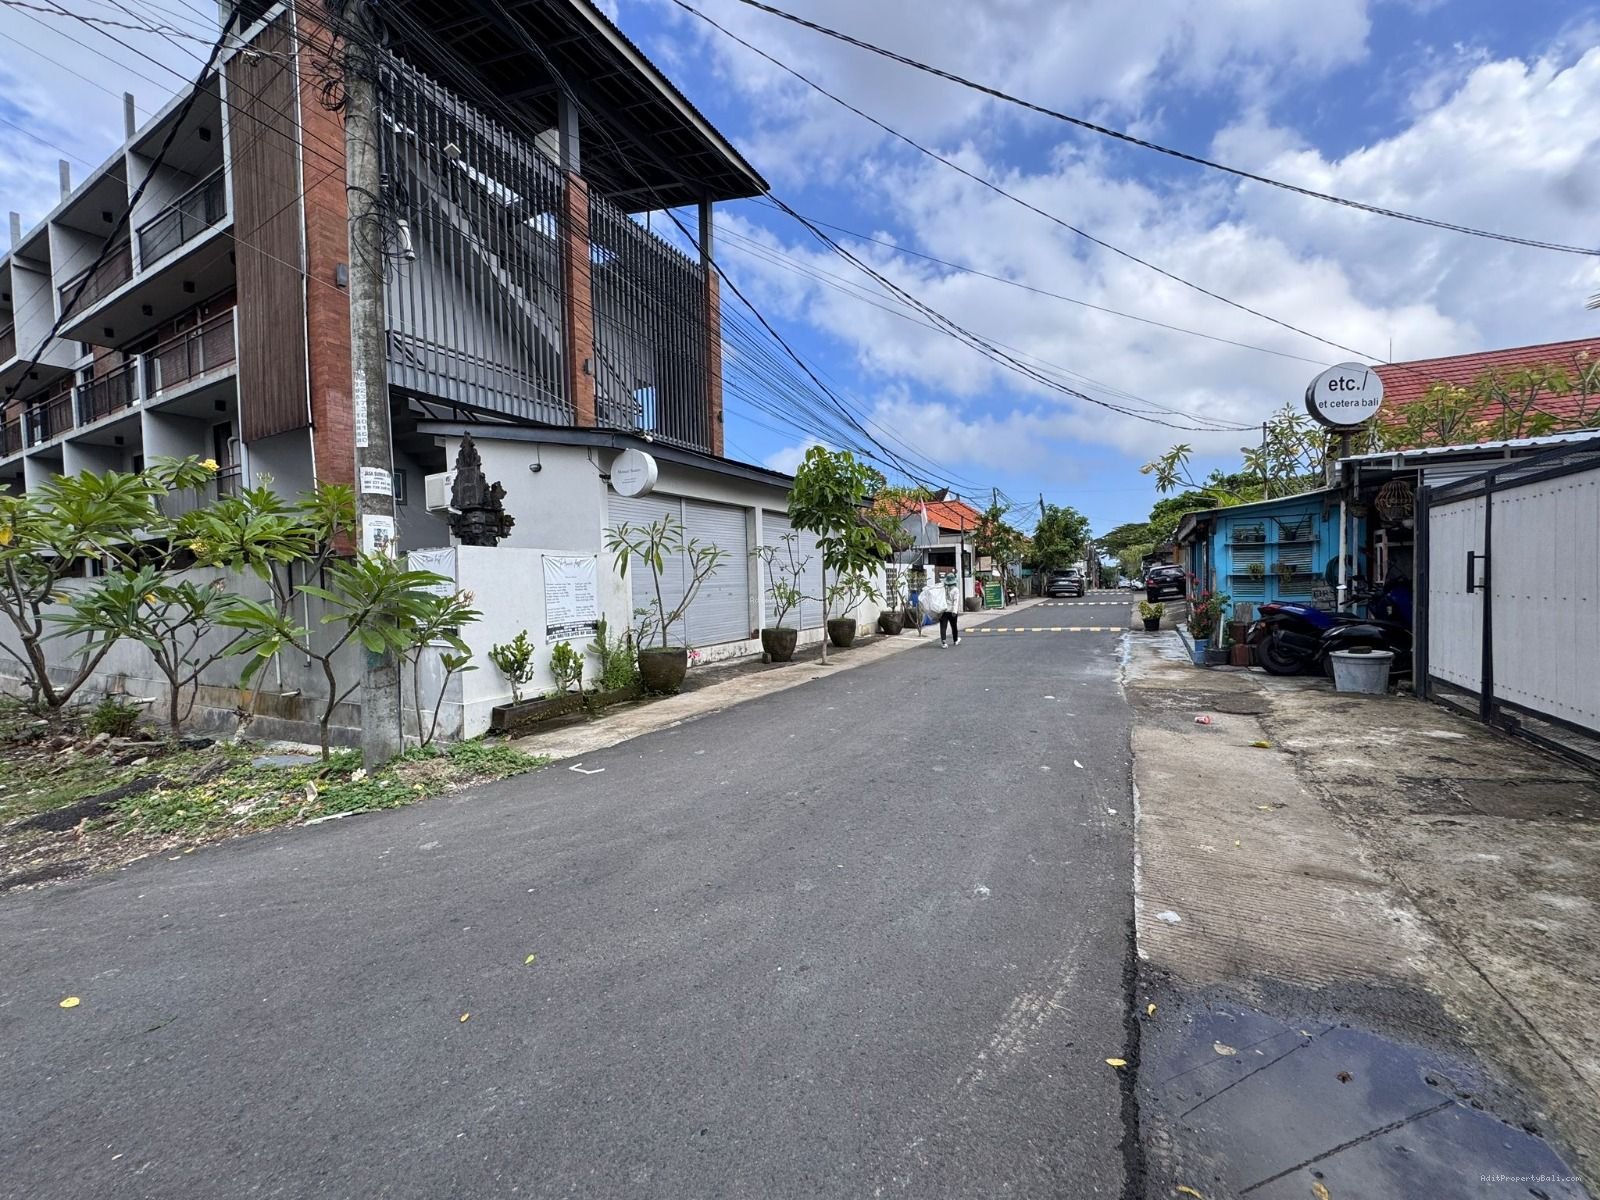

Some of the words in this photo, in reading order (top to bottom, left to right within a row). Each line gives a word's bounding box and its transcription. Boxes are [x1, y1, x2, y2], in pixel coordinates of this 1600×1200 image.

[1318, 400, 1327, 408] et
[1330, 399, 1359, 408] cetera
[1361, 398, 1379, 407] bali
